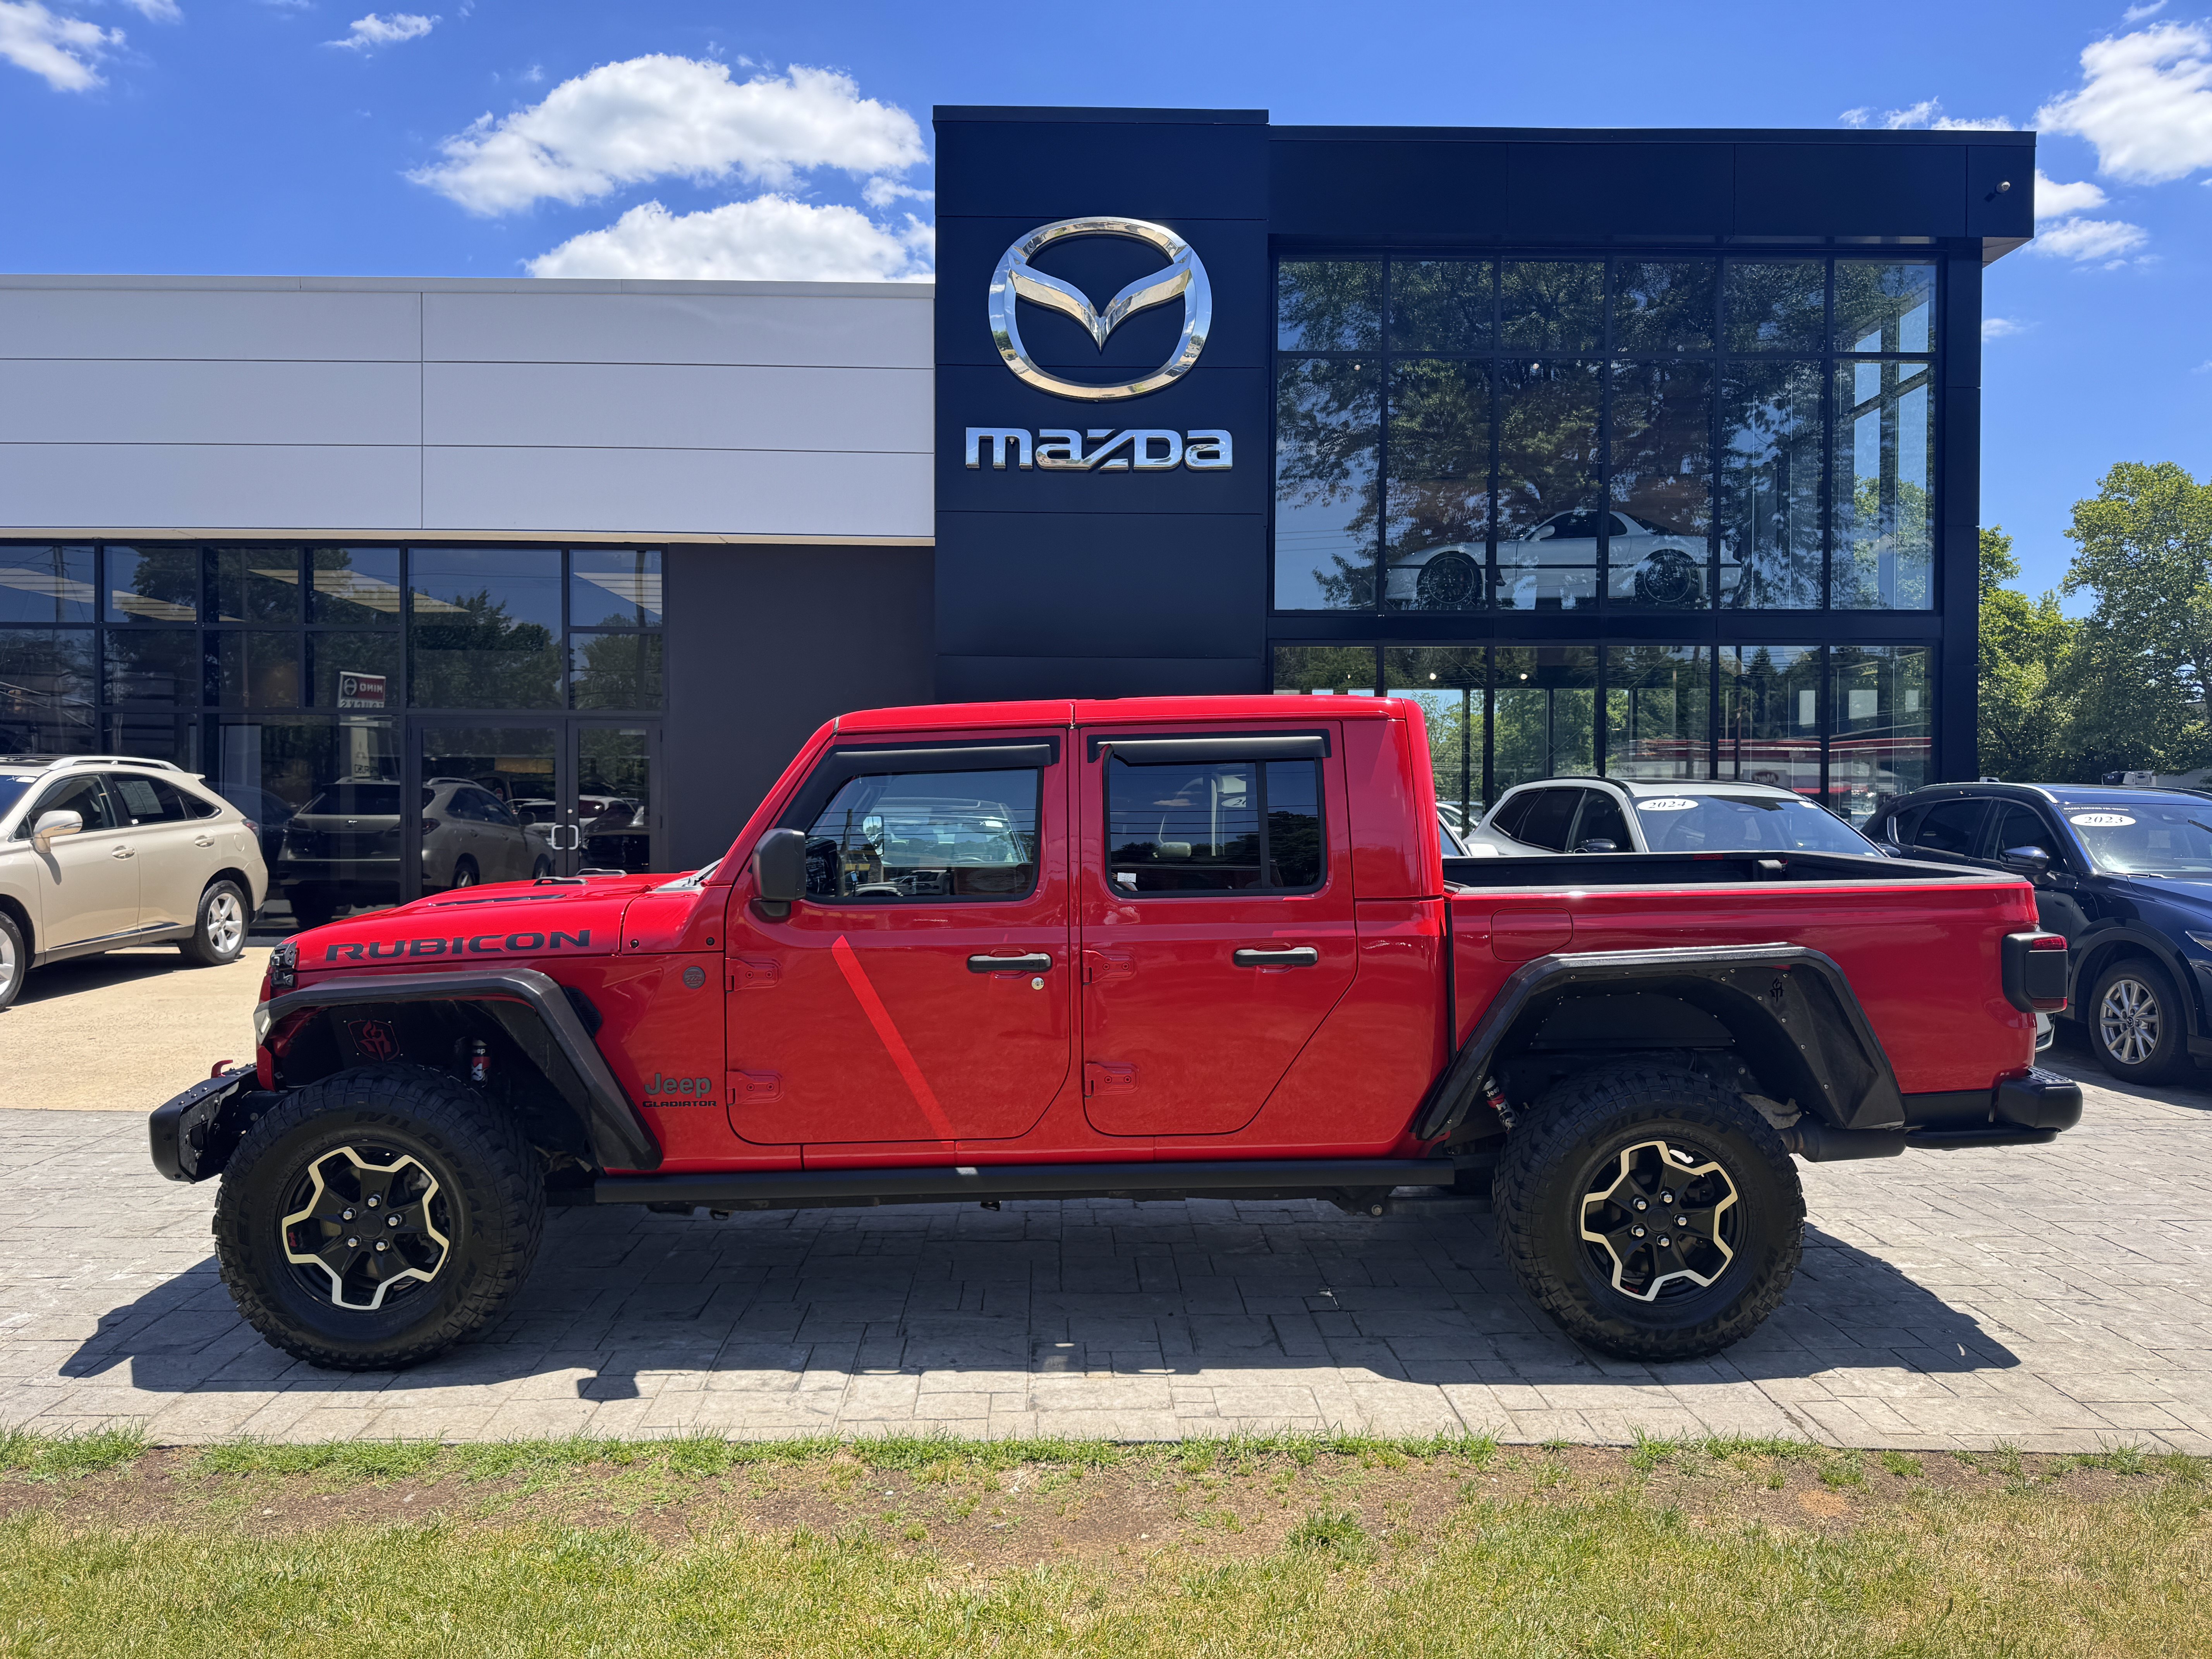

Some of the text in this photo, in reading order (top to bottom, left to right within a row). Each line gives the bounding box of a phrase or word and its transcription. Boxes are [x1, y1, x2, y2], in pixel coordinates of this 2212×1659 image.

[1649, 800, 1686, 809] 2024
[326, 930, 591, 962] RUBICON
[644, 1073, 711, 1097] Jeep
[1486, 1087, 1499, 1097] Jeep
[354, 1111, 483, 1240] WILDPEAK
